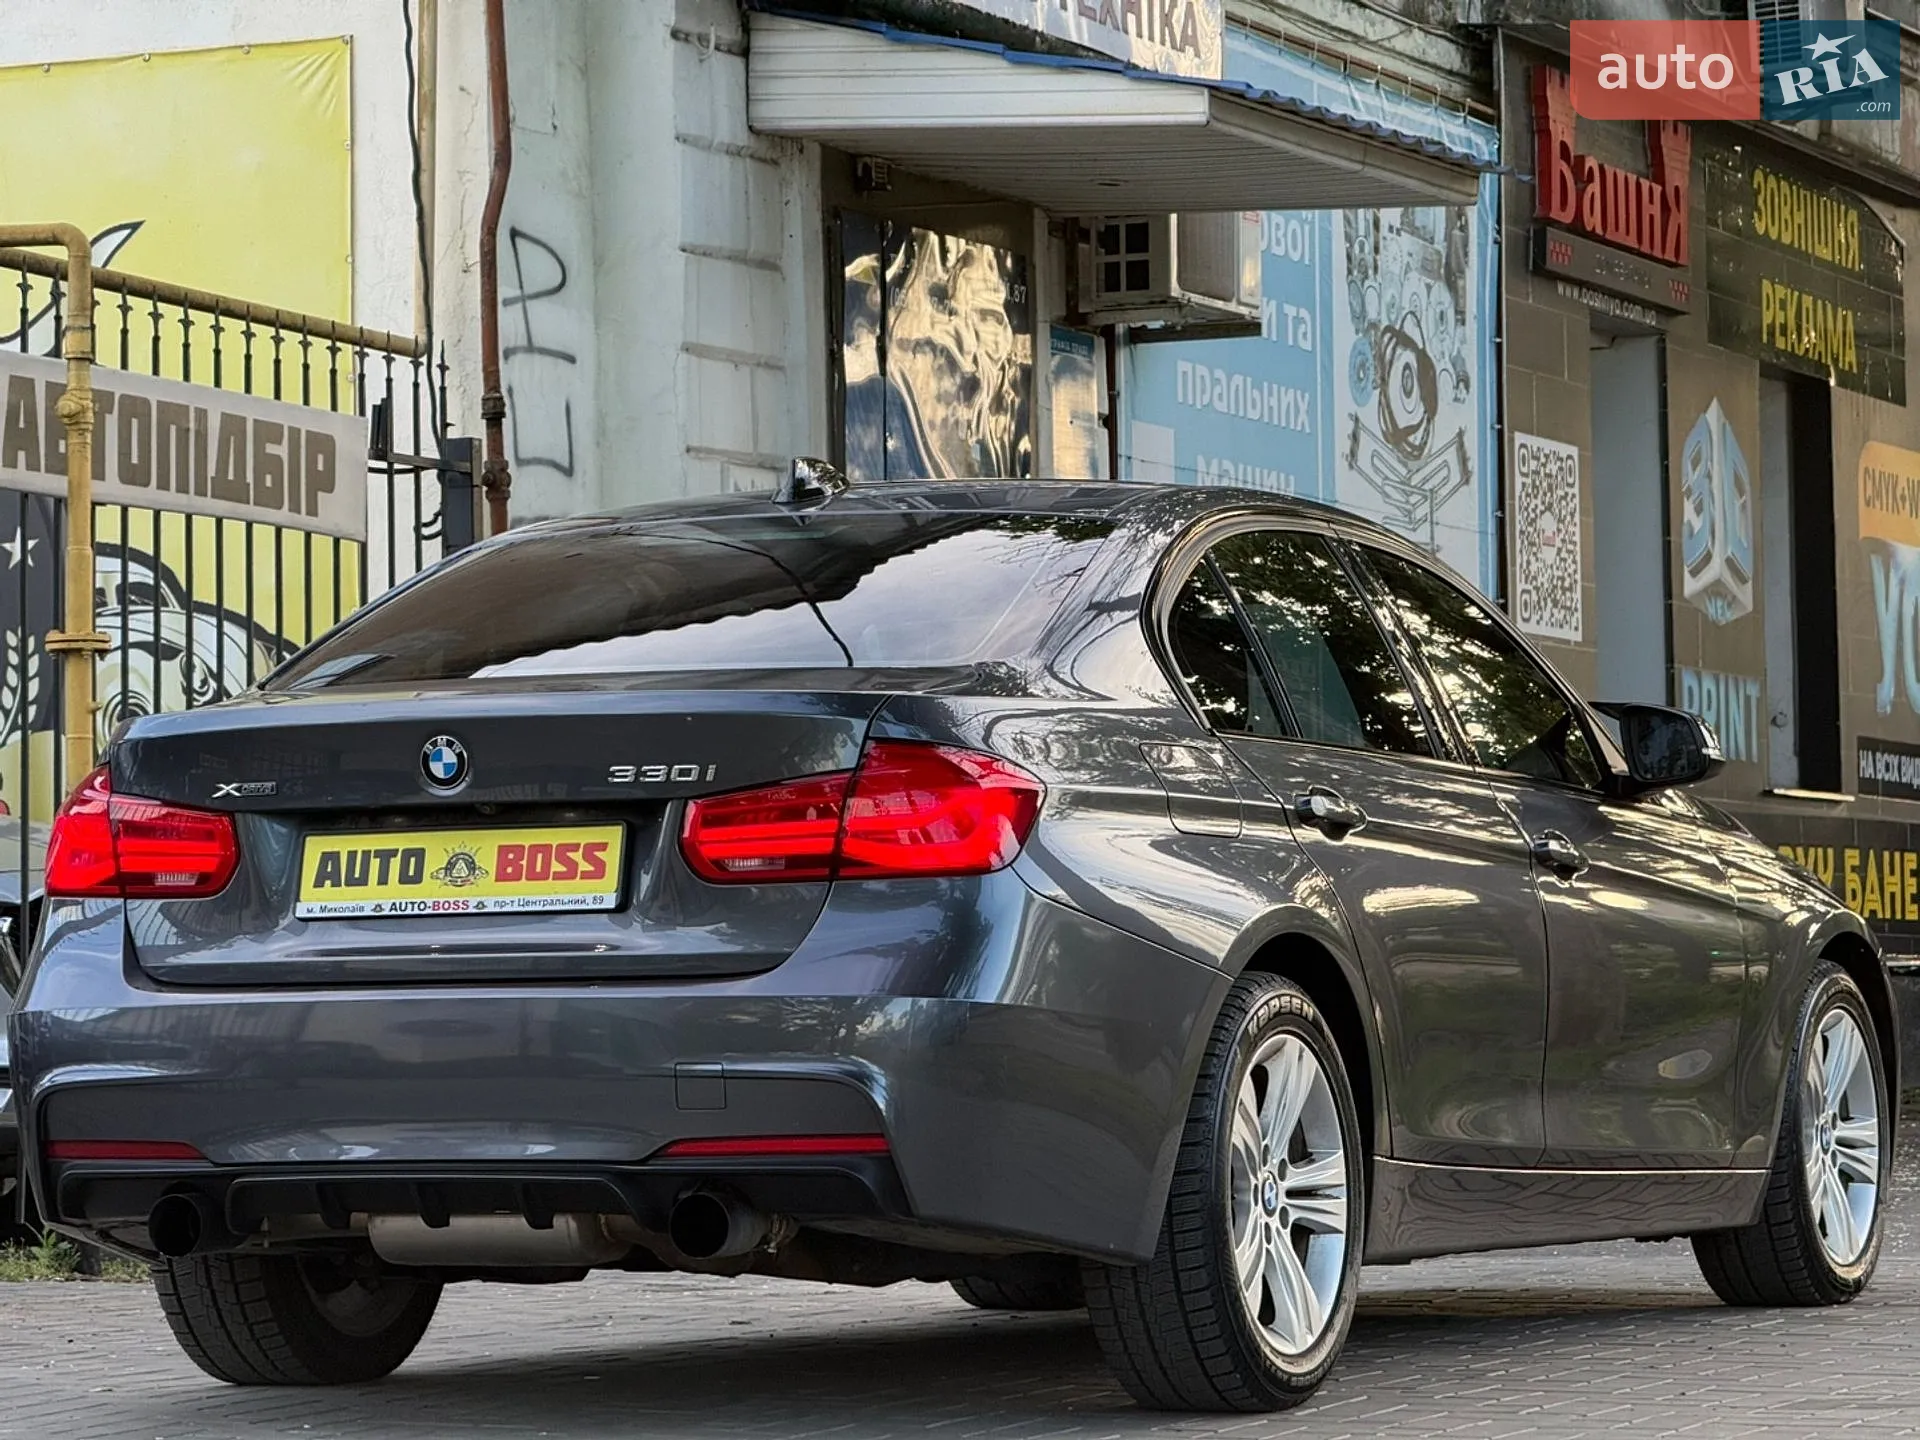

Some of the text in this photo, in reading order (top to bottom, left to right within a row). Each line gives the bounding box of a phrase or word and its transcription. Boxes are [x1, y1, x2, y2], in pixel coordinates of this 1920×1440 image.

[1059, 0, 1201, 58] ХНІКА
[1549, 120, 1690, 267] Башня
[1753, 168, 1860, 272] ЗОВНІШНЯ
[1283, 303, 1312, 351] та
[1761, 279, 1858, 374] РЕКЛАМА
[1177, 360, 1311, 433] пральних
[2, 375, 336, 518] АВТОПІДБІР
[1197, 455, 1295, 496] машин
[608, 764, 717, 782] 330i
[313, 847, 427, 889] AUTO
[494, 842, 609, 882] BOSS
[318, 904, 365, 914] Миколаїв
[517, 896, 590, 908] Центральний,
[592, 895, 604, 906] 89
